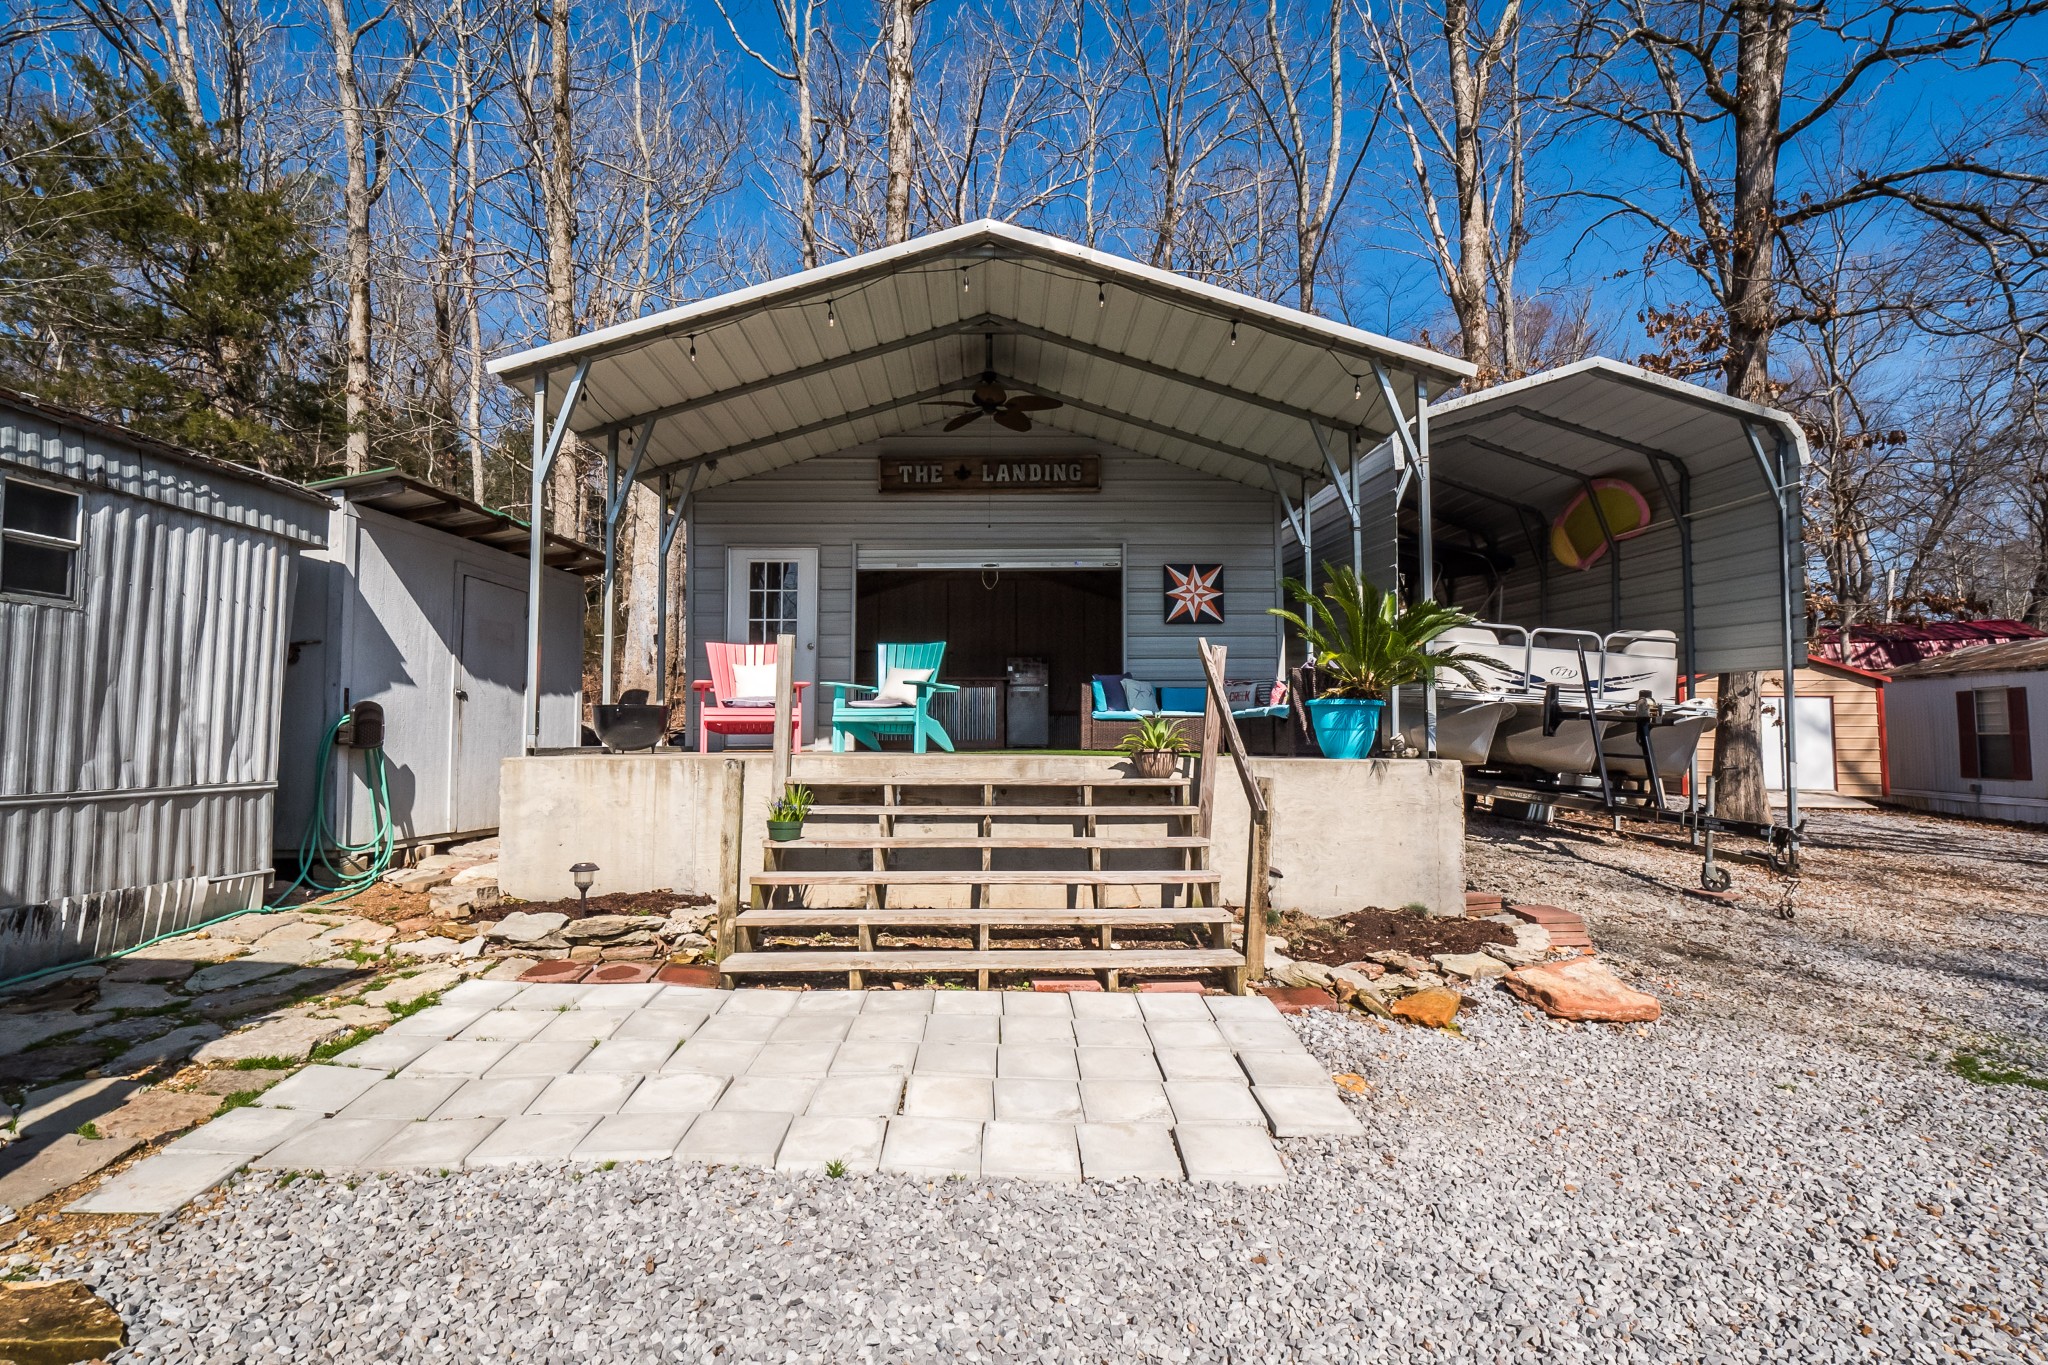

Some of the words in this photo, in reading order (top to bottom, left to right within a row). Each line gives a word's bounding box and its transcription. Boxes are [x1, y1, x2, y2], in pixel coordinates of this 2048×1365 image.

[899, 465, 942, 483] THE
[982, 463, 1082, 482] LANDING
[1501, 789, 1542, 801] ENNESSEE
